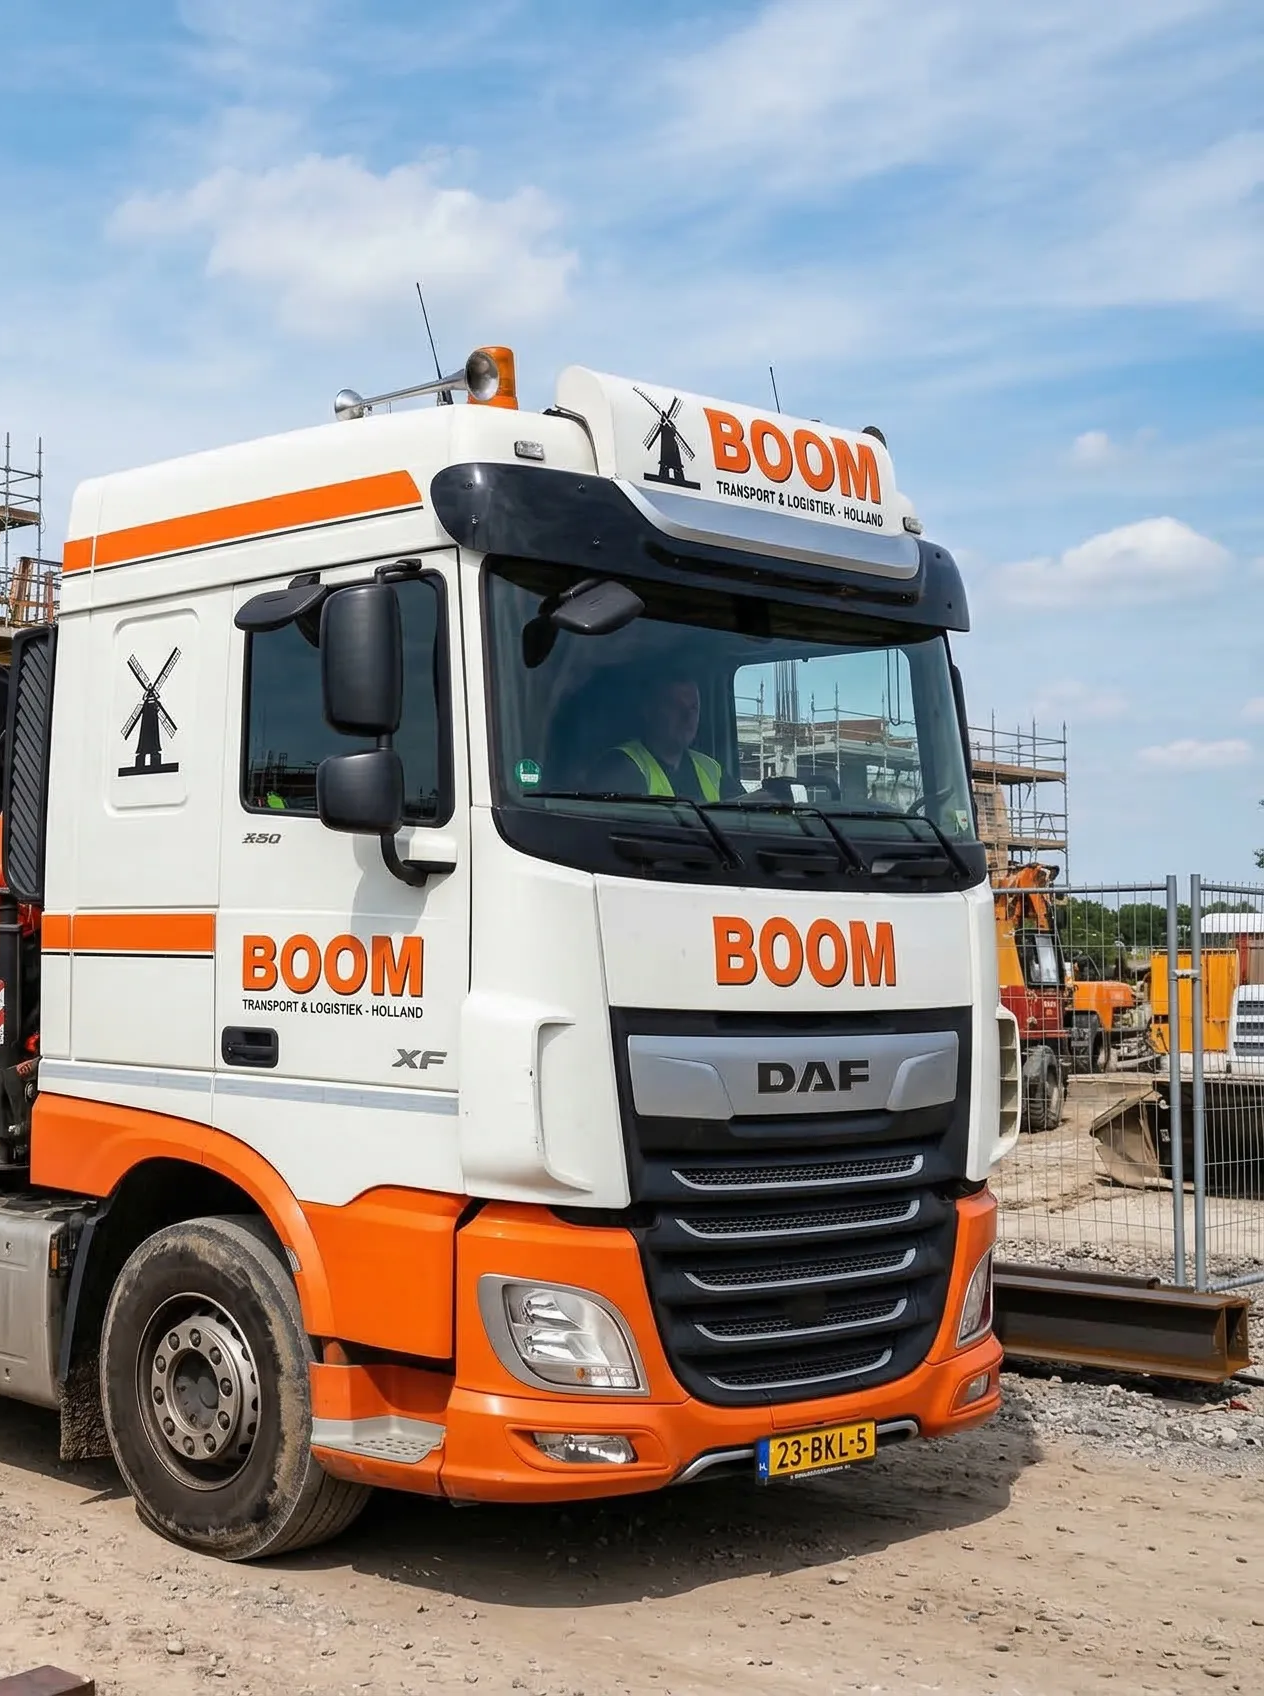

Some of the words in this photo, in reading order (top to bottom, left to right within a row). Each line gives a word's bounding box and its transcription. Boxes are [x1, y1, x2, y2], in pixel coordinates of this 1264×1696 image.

[703, 407, 882, 505] BOOM
[716, 480, 776, 504] TRANSPORT
[778, 492, 785, 506] &
[787, 494, 836, 517] LOGISTIEK
[843, 506, 884, 528] HOLLAND
[242, 933, 424, 998] BOOM
[712, 916, 897, 988] BOOM
[242, 998, 299, 1013] TRANSPORT
[300, 1001, 308, 1013] &
[310, 1002, 364, 1016] LOGISTIEK
[371, 1004, 424, 1019] HOLLAND
[391, 1048, 448, 1070] XF
[757, 1059, 870, 1094] DAF
[776, 1427, 867, 1470] 23-BKL-5
